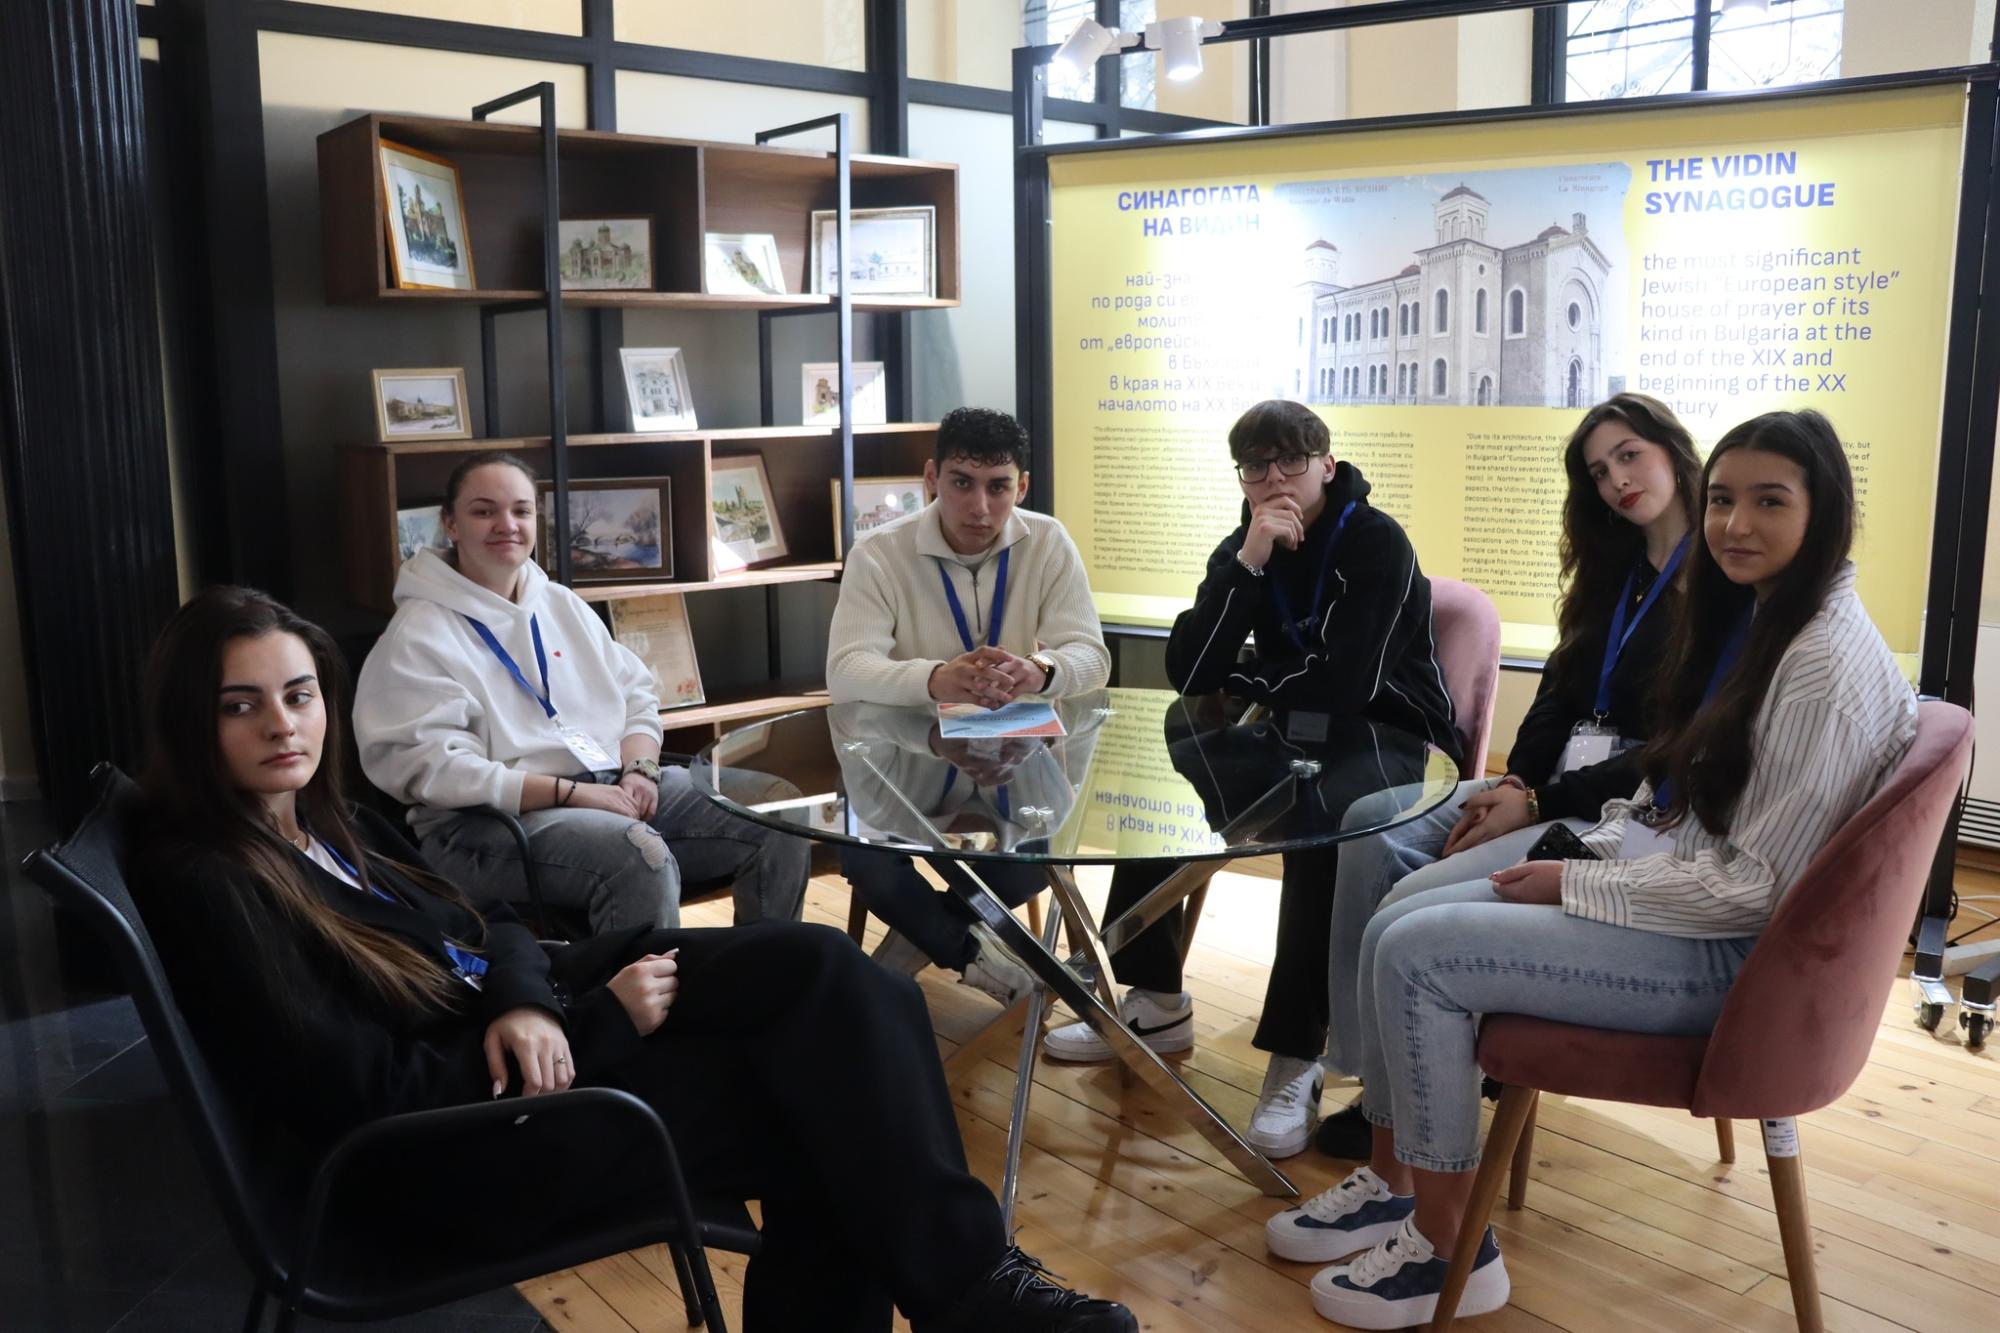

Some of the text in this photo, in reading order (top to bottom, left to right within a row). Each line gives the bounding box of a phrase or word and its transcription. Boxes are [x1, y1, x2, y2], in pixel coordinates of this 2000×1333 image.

[1646, 151, 1797, 182] THE VIDIN
[1117, 184, 1261, 211] СИНАГОГАТА
[1645, 183, 1836, 215] SYNAGOGUE
[1143, 217, 1174, 237] НА
[1643, 248, 1861, 273] the most significant
[1642, 276, 1708, 296] Jewish
[1092, 296, 1110, 309] по
[1114, 295, 1152, 311] рода
[1157, 295, 1175, 308] си
[1641, 297, 1869, 320] house of prayer of its
[1080, 336, 1104, 350] от
[1641, 323, 1872, 345] kind in Bulgaria at the
[1640, 348, 1833, 366] end of the XIX and
[1109, 375, 1118, 391] в
[1123, 375, 1159, 393] края
[1164, 379, 1182, 391] на
[1639, 373, 1847, 395] beginning of the XX
[1098, 399, 1177, 412] началото
[1183, 400, 1201, 412] на
[1665, 400, 1718, 418] ntury
[1509, 465, 1517, 473] by
